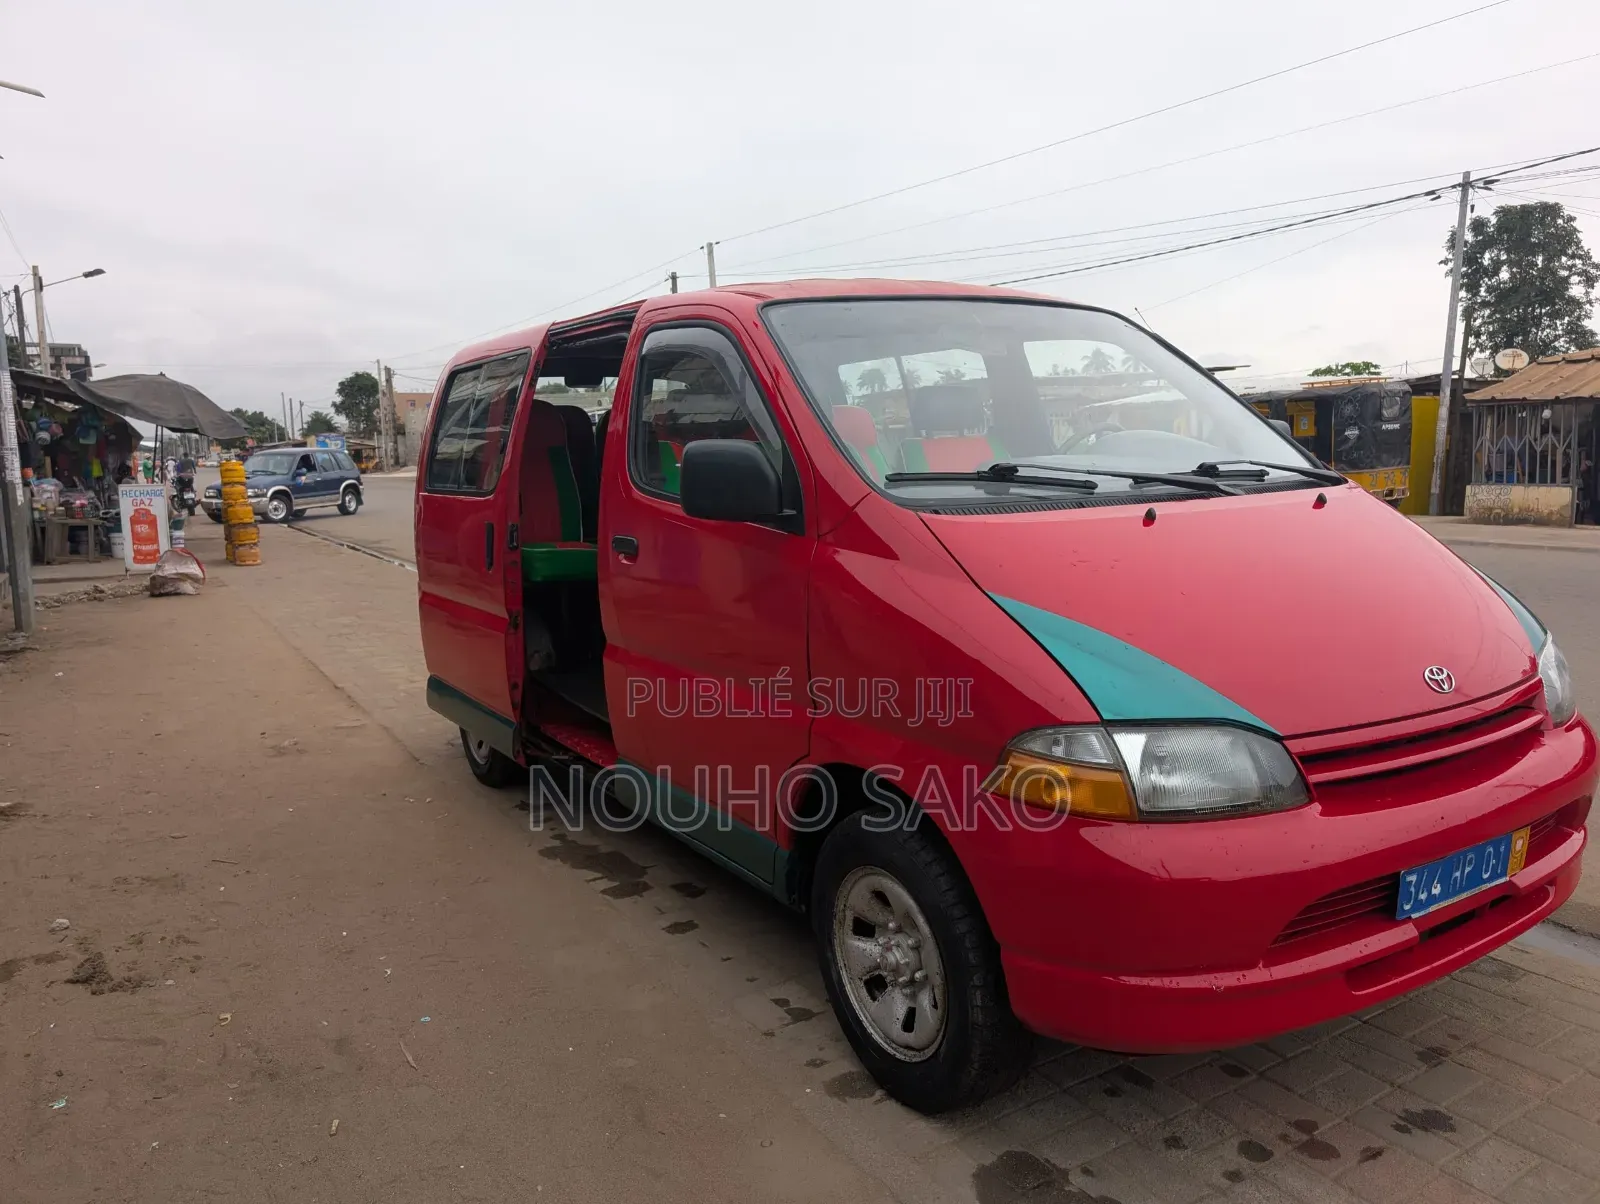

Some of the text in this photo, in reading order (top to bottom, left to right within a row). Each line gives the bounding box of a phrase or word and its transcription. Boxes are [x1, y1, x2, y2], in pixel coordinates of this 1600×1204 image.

[121, 489, 164, 498] RECHARGE
[132, 498, 154, 507] GAZ
[1449, 853, 1476, 892] HP
